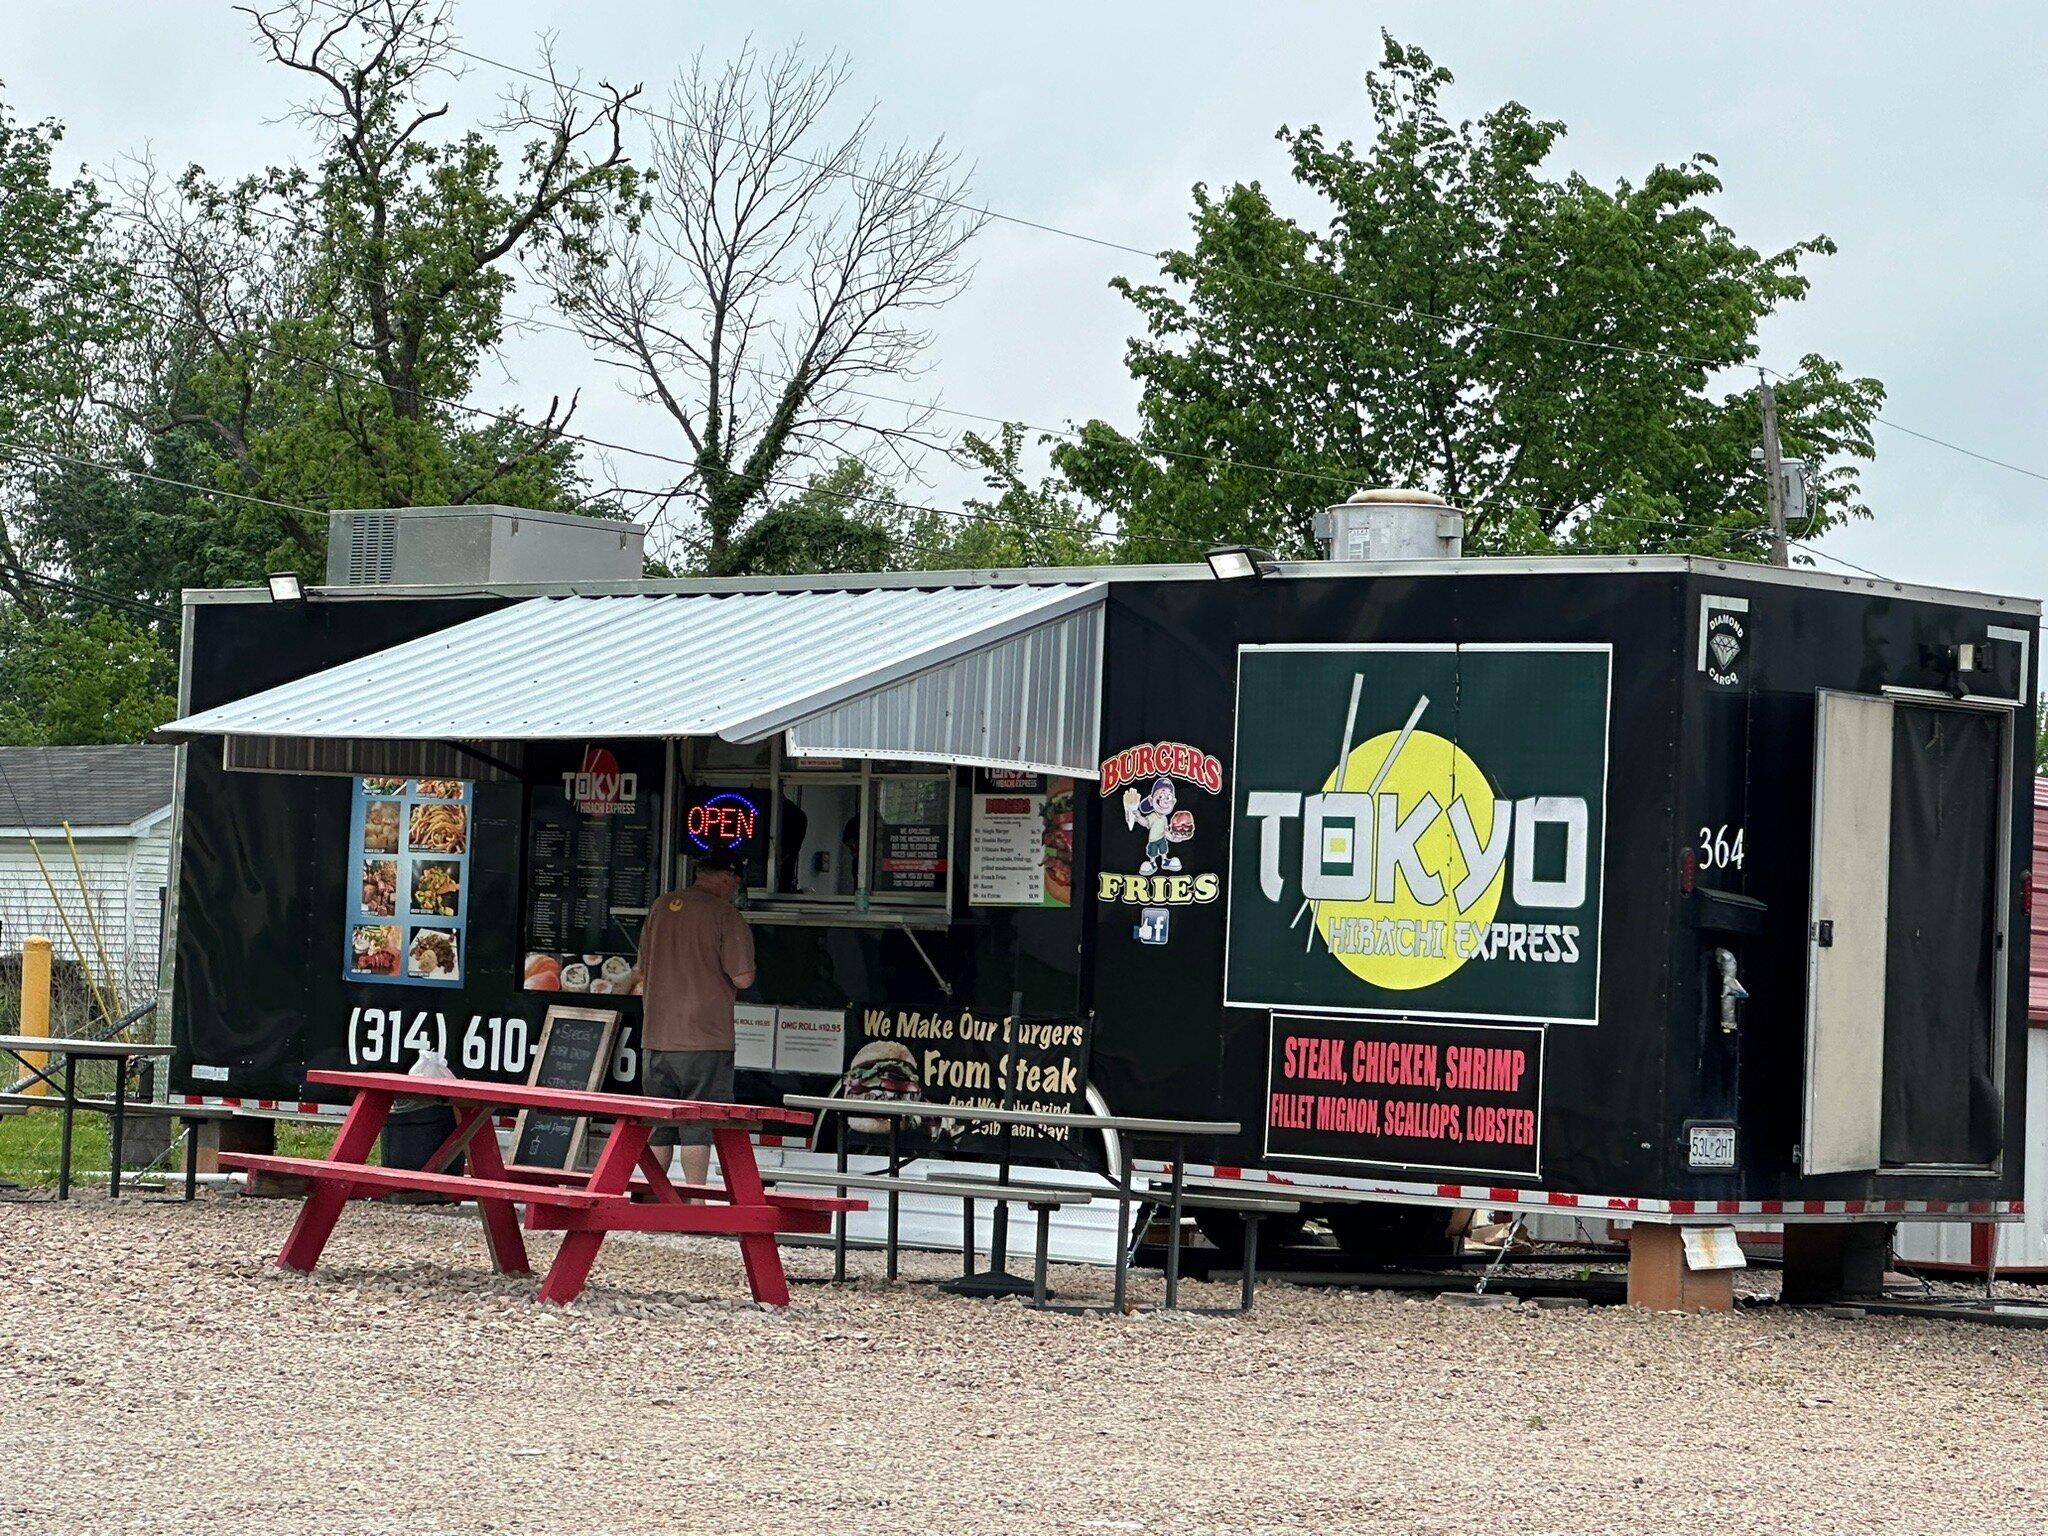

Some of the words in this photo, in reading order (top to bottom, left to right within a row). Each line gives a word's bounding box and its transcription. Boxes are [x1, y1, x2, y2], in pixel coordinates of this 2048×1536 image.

[1709, 614, 1744, 638] DIAMOND
[1709, 667, 1737, 685] CARGO
[562, 772, 637, 801] TOKYO
[1101, 742, 1221, 796] BURGERS
[580, 802, 605, 814] HIBACHI
[606, 802, 636, 815] EXPRESS
[688, 806, 754, 838] OPEN
[1247, 791, 1588, 914] TOKYO
[1699, 824, 1744, 869] 364
[1099, 872, 1218, 904] FRIES
[1328, 916, 1447, 959] HIBACHI
[1454, 921, 1580, 963] EXPRESS
[348, 1007, 447, 1065] (314)
[781, 1021, 797, 1030] OMG
[798, 1022, 817, 1031] ROLL
[864, 1009, 891, 1037] We
[896, 1011, 954, 1040] Make
[959, 1012, 999, 1042] Our
[923, 1049, 991, 1089] From
[1284, 1036, 1348, 1085] STEAK,
[1352, 1040, 1441, 1091] CHICKEN,
[1445, 1045, 1525, 1092] SHRIMP
[1271, 1093, 1315, 1130] FILLET
[1316, 1096, 1380, 1138] MIGNON,
[1384, 1100, 1463, 1144] SCALLOPS,
[1466, 1105, 1534, 1145] LOBSTER
